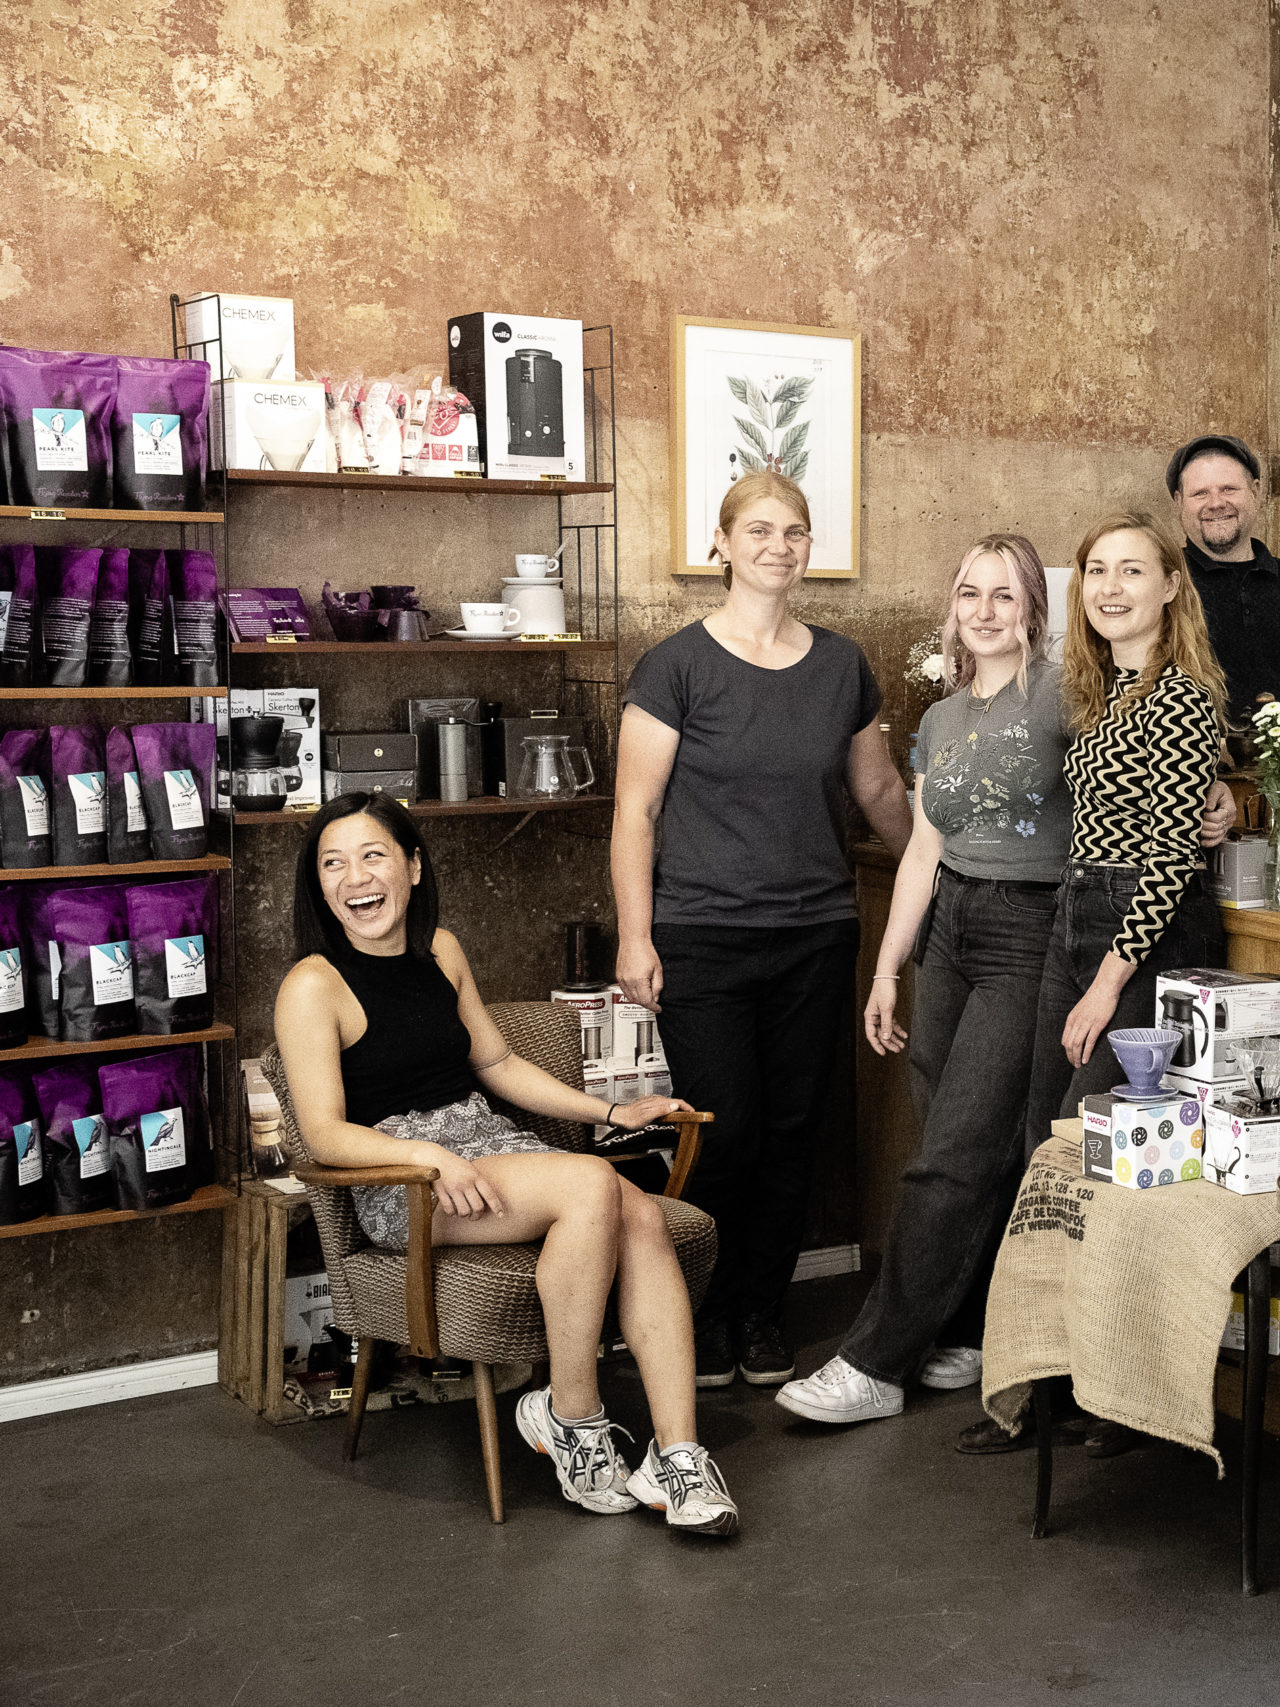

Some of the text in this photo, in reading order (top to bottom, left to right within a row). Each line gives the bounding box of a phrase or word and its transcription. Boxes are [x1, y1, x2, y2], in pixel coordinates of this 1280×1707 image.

[222, 307, 276, 322] CHEMEX
[517, 333, 538, 341] CLASSIC
[253, 392, 307, 407] CHEMEX
[568, 462, 574, 471] 5
[268, 702, 300, 712] Skerton
[95, 976, 123, 985] BLACKCAP
[170, 972, 197, 980] BLACKCAP
[1087, 1115, 1108, 1127] HARIO
[1032, 1170, 1045, 1182] LOT
[1076, 1187, 1094, 1201] 120
[1018, 1194, 1081, 1213] ORGANIC COFFEE
[1011, 1209, 1031, 1225] CAFE
[1034, 1207, 1046, 1218] DE
